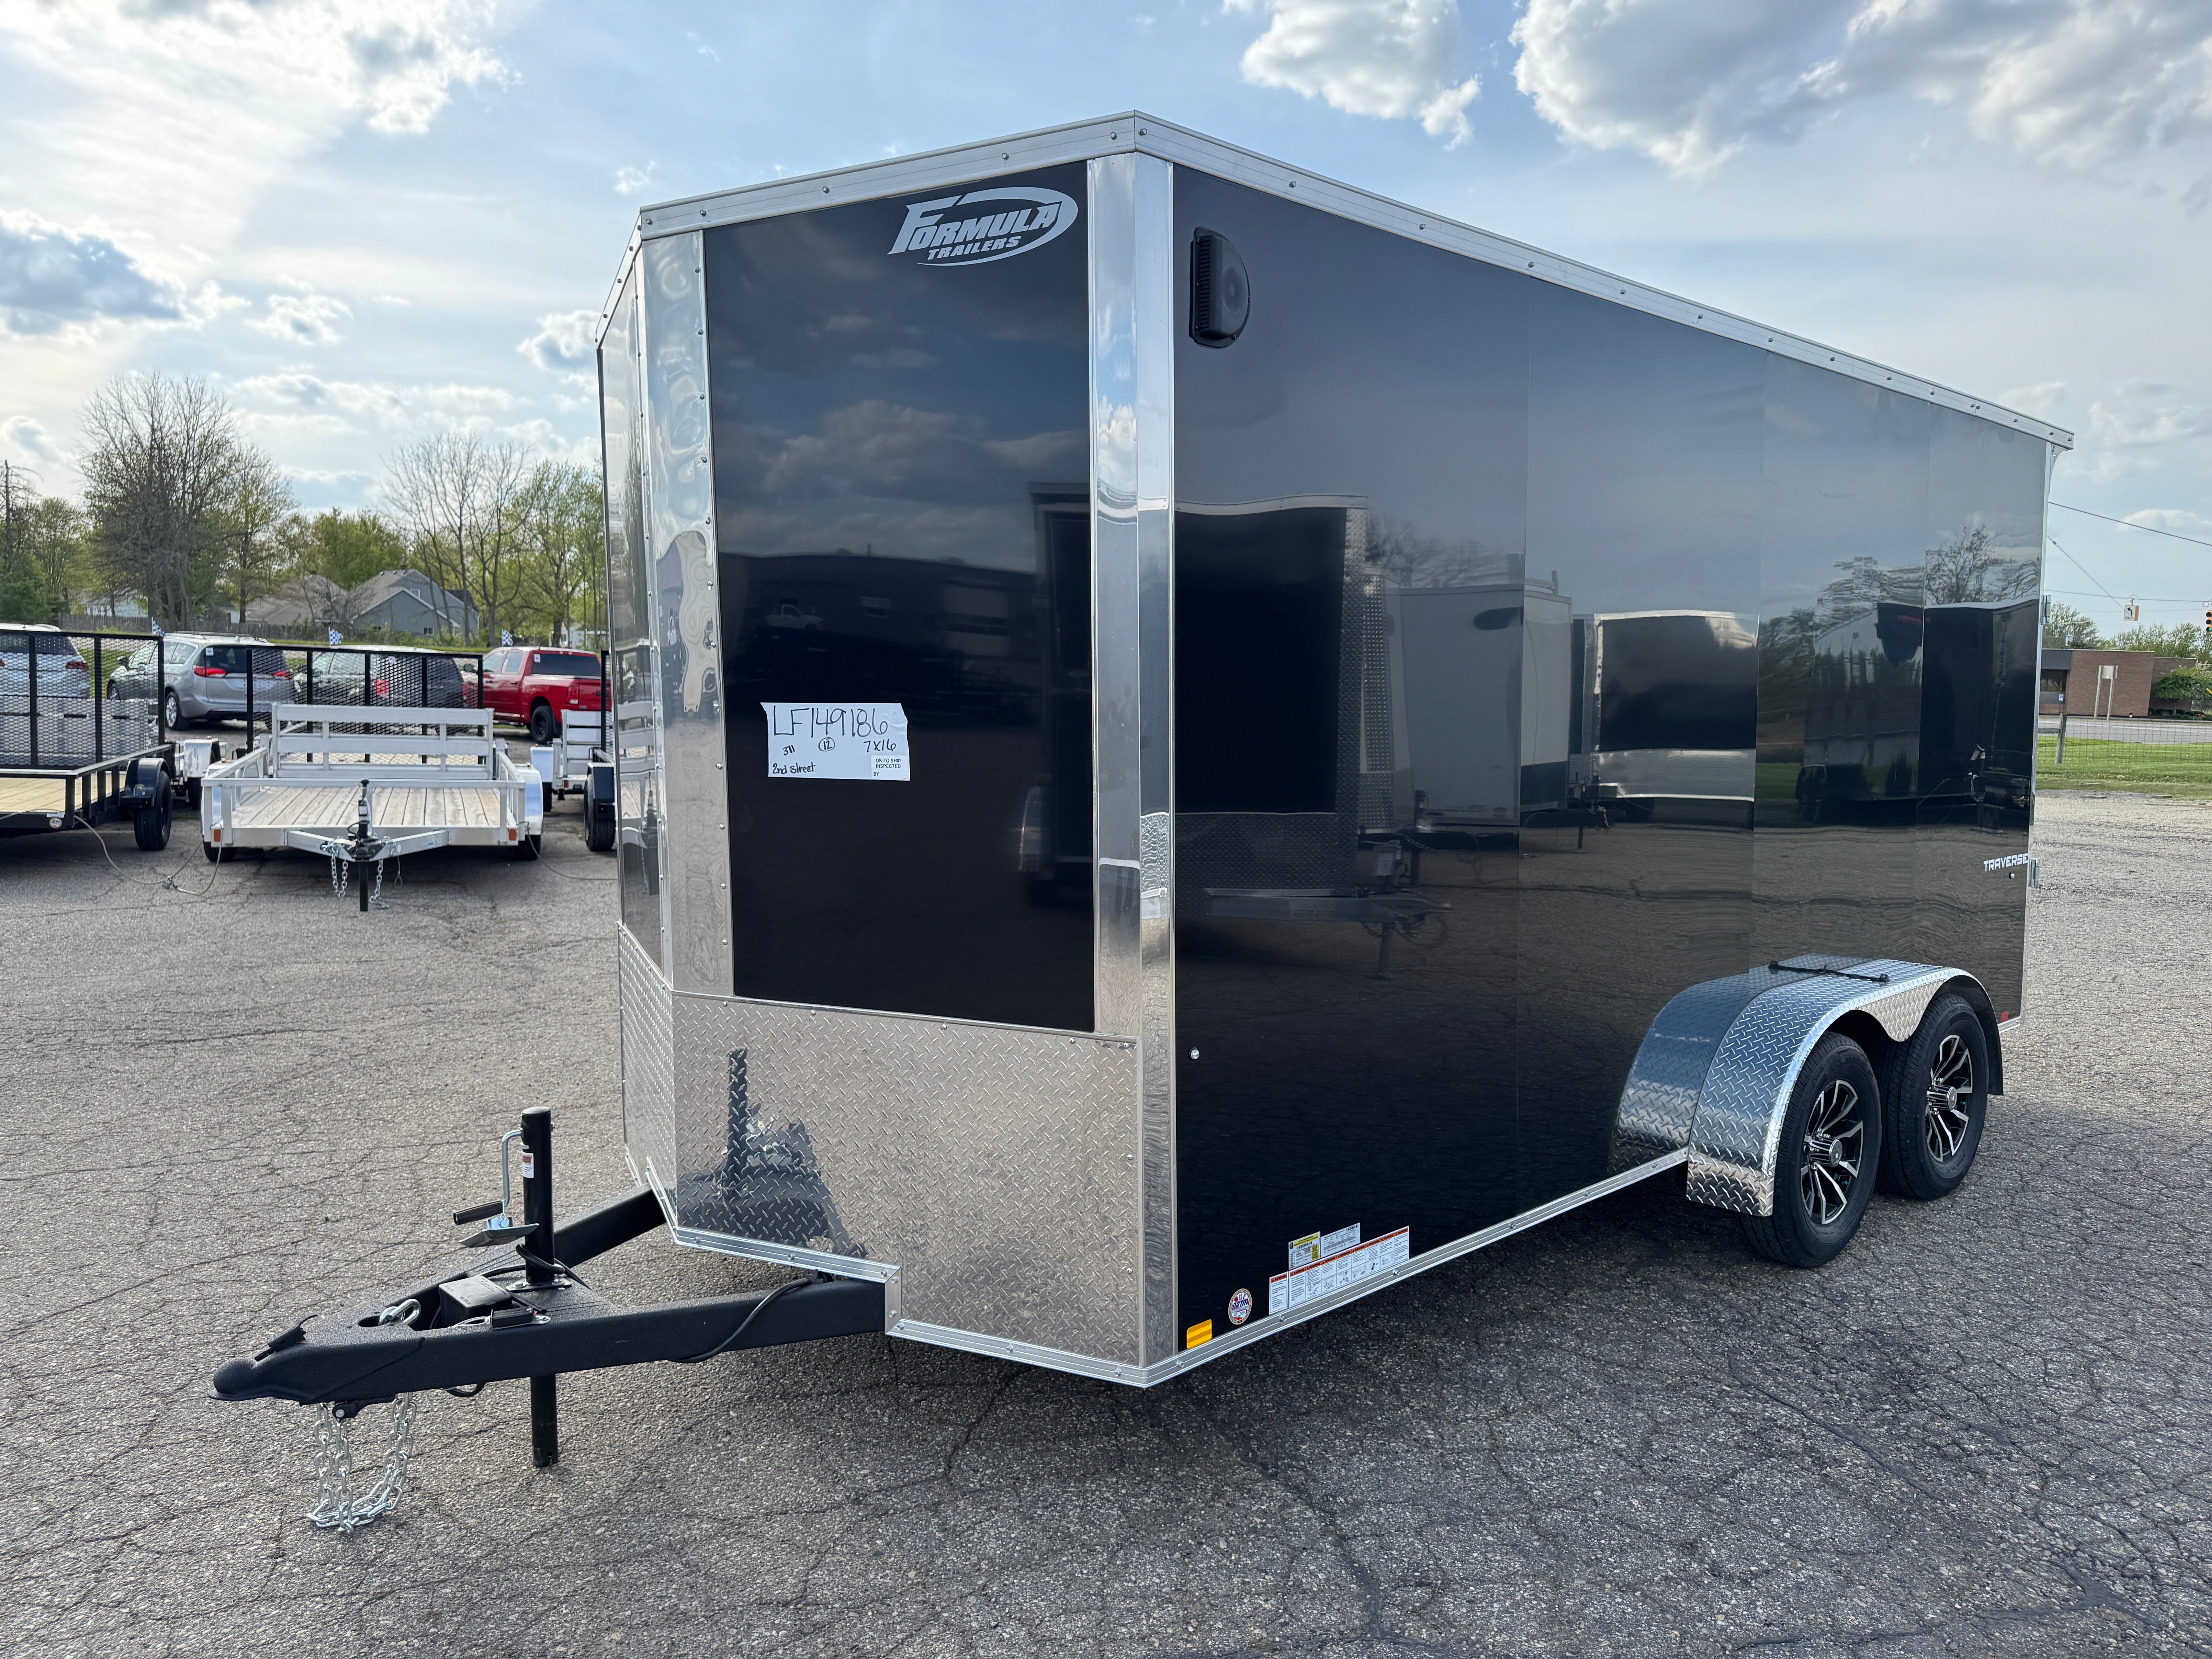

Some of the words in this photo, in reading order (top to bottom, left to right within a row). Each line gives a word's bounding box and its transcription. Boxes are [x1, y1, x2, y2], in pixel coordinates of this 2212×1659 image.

[887, 196, 1061, 254] FORMULA
[928, 236, 1021, 260] TRAILERS
[774, 705, 888, 738] LF149186
[823, 740, 832, 750] 12
[773, 763, 787, 774] 2nd
[1984, 853, 2028, 872] TRAVERSE
